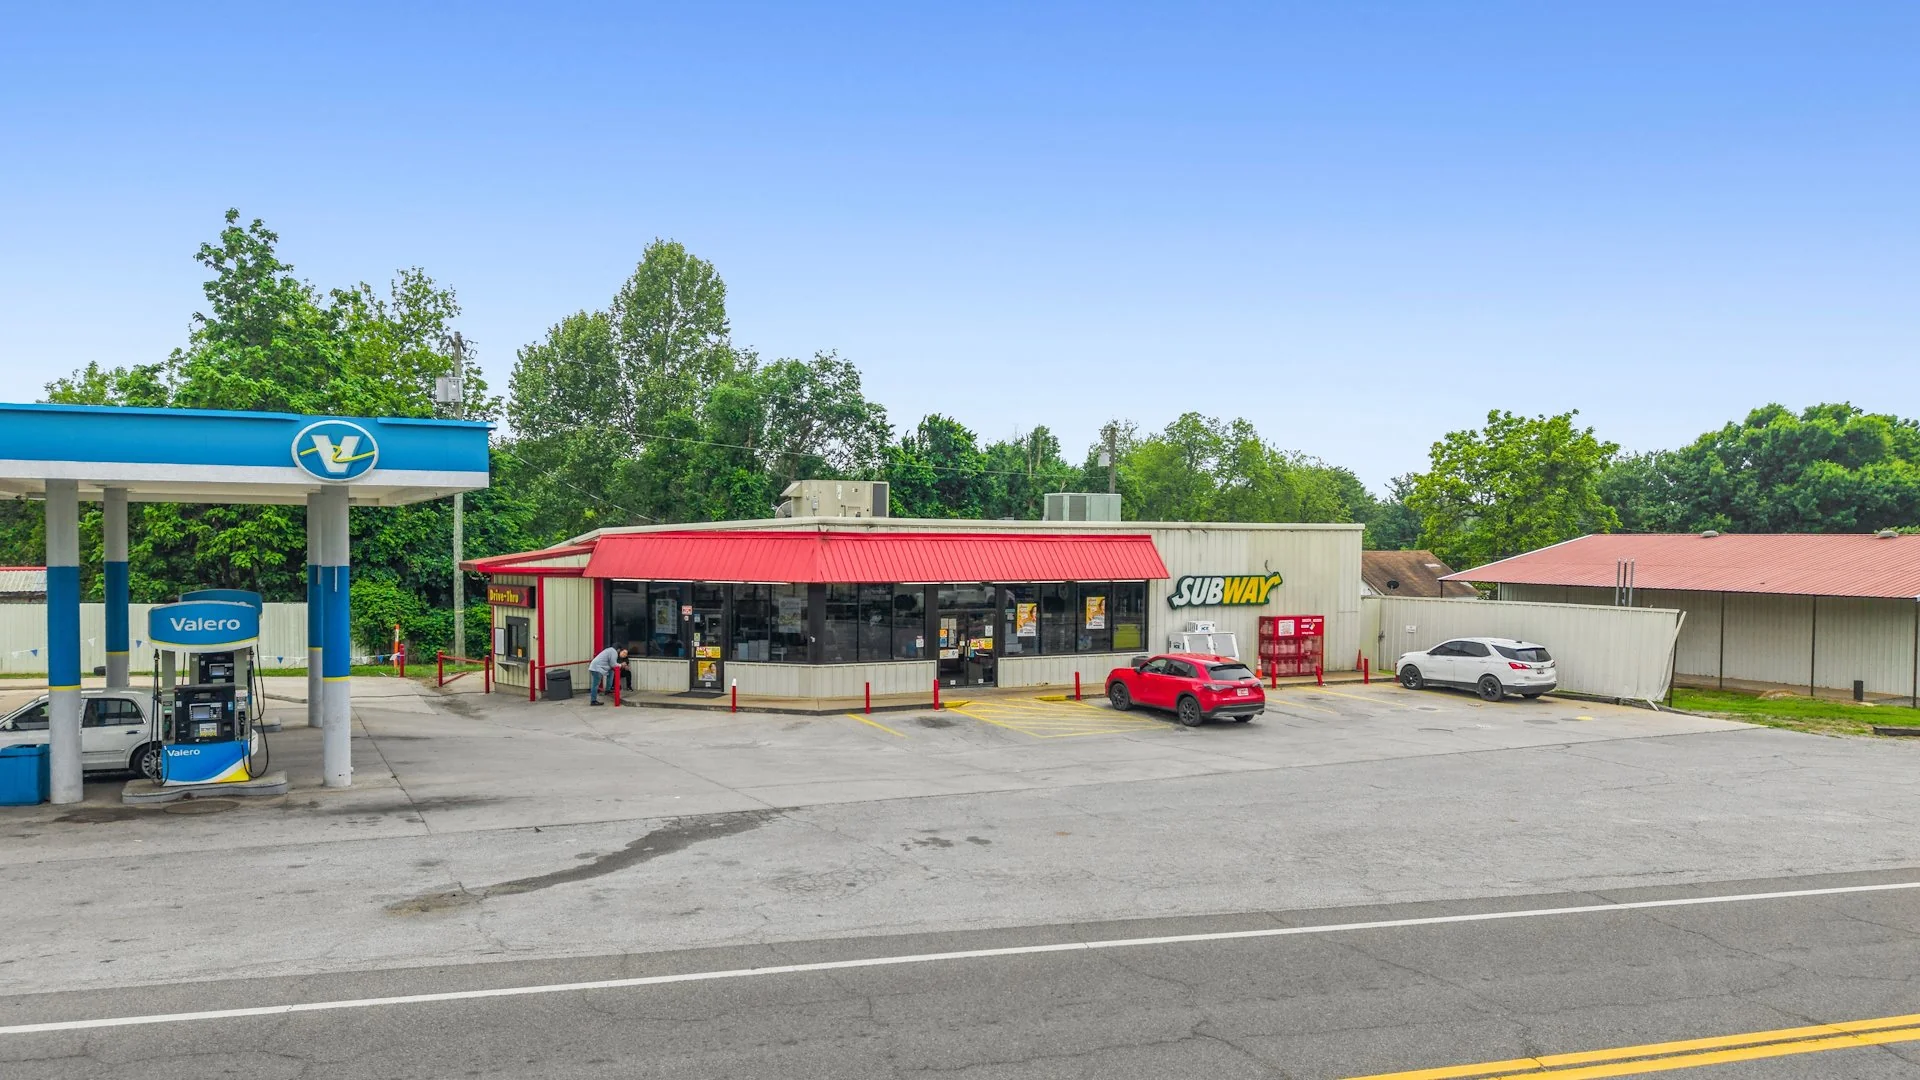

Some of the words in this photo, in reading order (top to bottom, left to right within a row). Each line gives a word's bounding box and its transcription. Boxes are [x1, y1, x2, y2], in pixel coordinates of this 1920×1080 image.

[490, 589, 519, 603] Drive-Thru
[1172, 575, 1281, 607] SUBWAY
[170, 617, 241, 632] Valero
[167, 749, 201, 757] Valero
